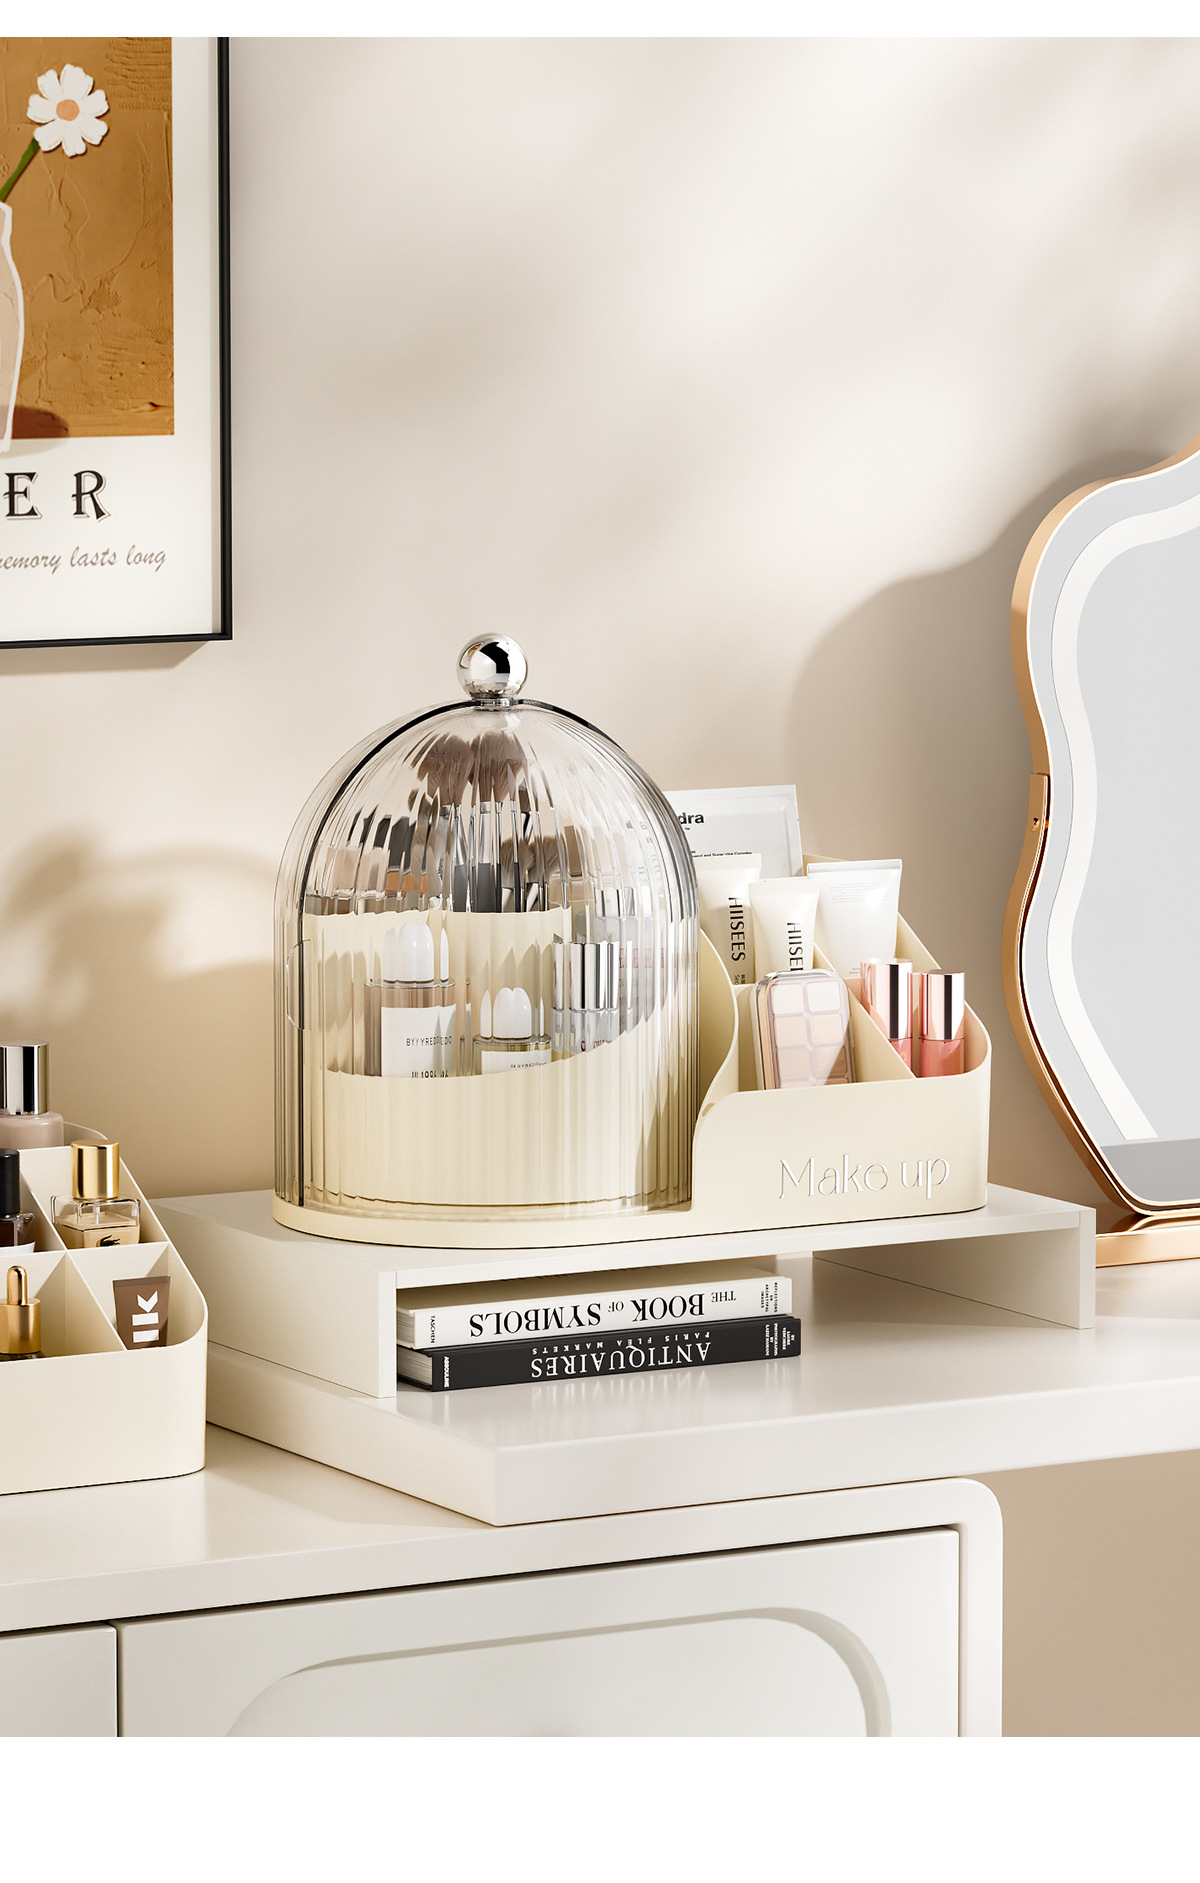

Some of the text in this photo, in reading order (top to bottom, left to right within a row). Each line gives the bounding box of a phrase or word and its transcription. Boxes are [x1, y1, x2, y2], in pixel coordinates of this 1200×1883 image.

[0, 544, 167, 575] emory lasts long
[728, 897, 746, 962] HIISEES
[778, 1153, 951, 1200] Make up
[469, 1290, 737, 1338] THE BOOK OF SYMBOLS
[530, 1341, 711, 1378] ANTIQUAIRES
[532, 1331, 711, 1355] PARIS FLEA MARKETS
